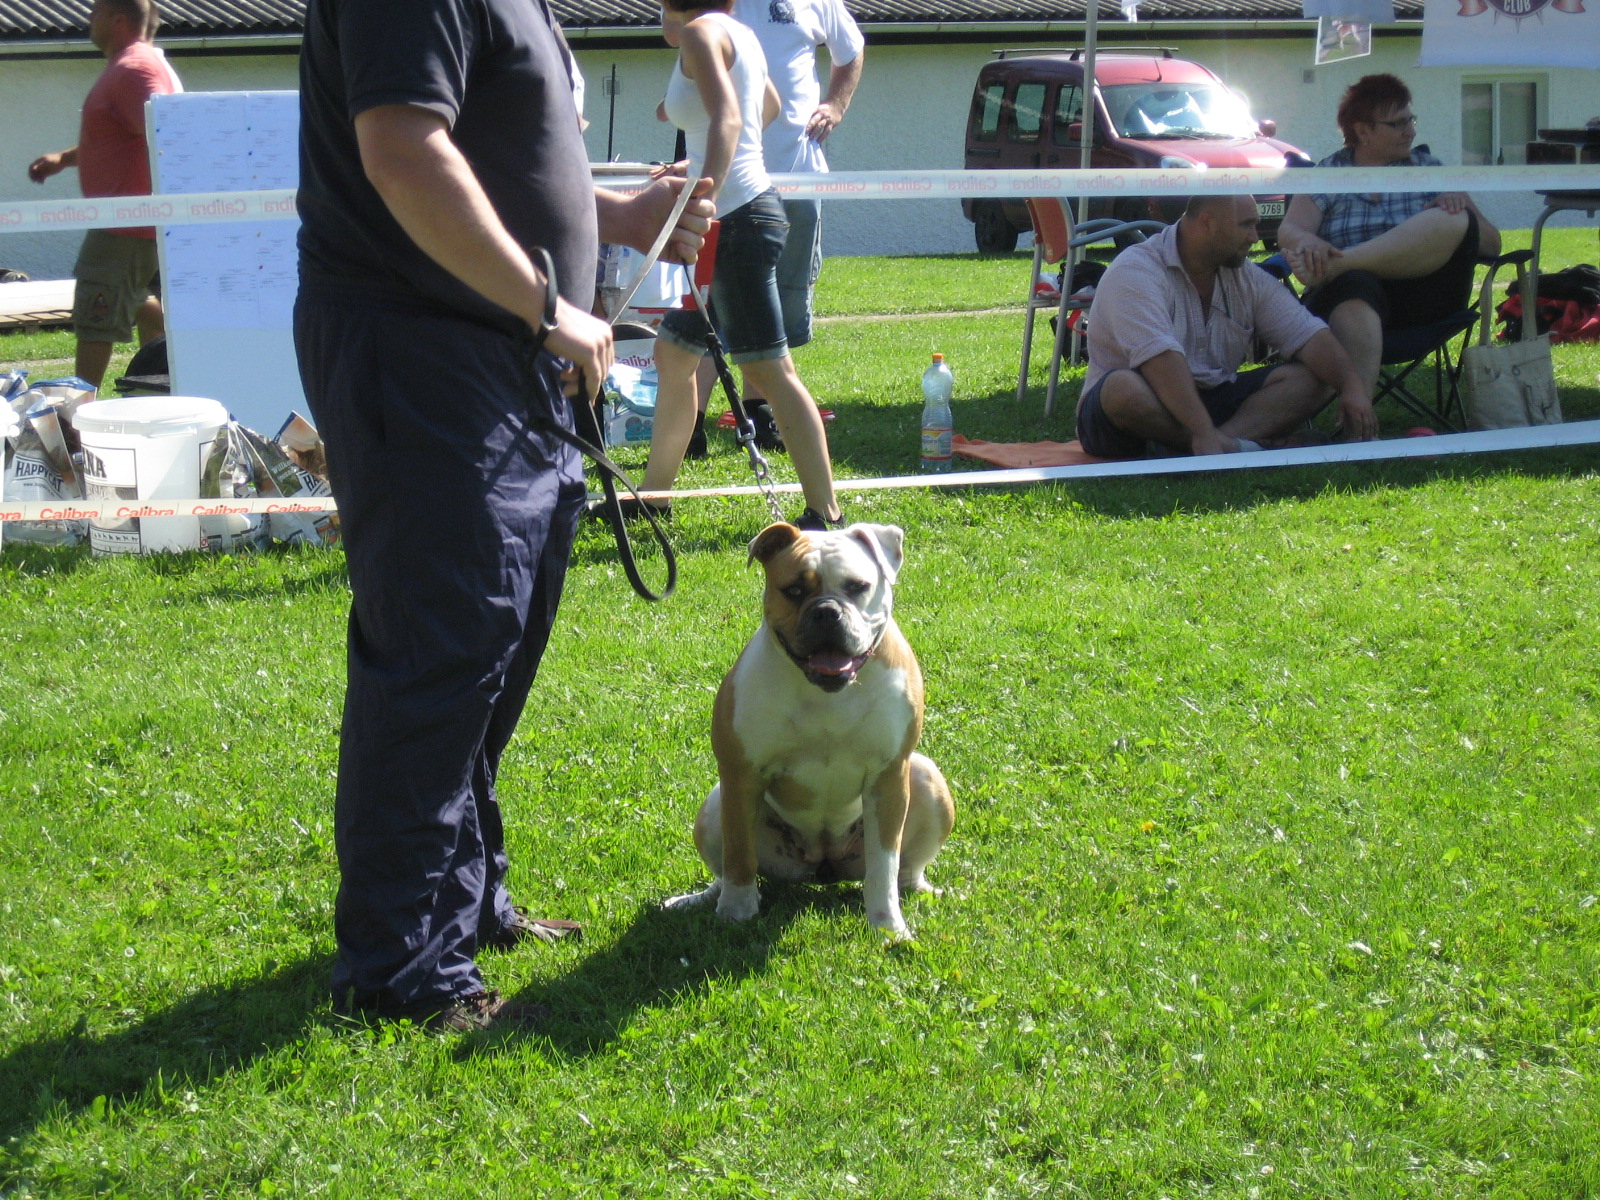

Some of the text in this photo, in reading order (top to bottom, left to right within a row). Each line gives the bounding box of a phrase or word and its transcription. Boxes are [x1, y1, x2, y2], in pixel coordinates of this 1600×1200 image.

[1503, 0, 1531, 13] CLUB
[1261, 204, 1281, 215] 3769
[39, 507, 99, 520] Calibra
[116, 505, 175, 518] Calibra
[191, 504, 248, 515] Calibra
[266, 503, 324, 513] Calibra
